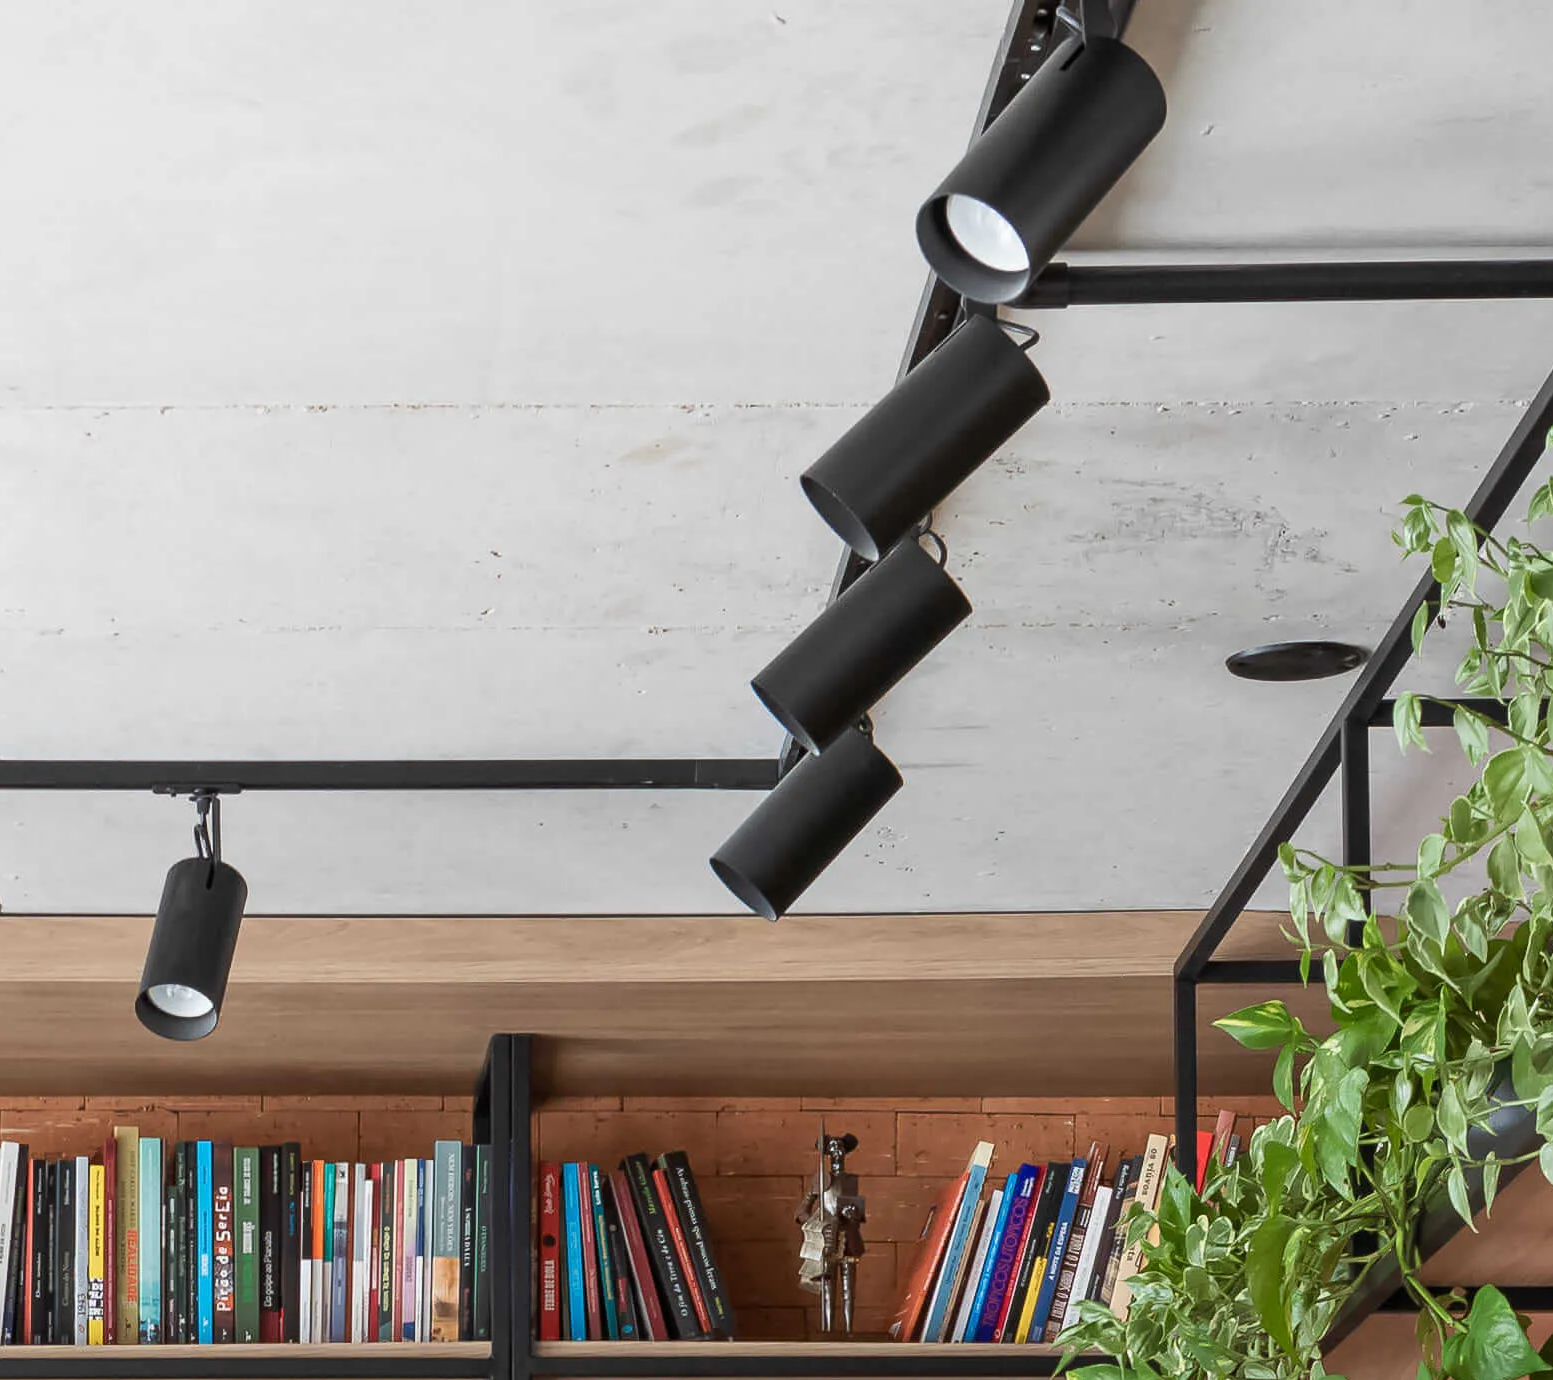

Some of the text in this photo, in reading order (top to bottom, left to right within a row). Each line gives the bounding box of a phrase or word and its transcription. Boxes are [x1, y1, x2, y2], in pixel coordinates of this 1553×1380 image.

[688, 1221, 705, 1239] que
[215, 1245, 233, 1265] de
[692, 1238, 712, 1267] poucos
[126, 1229, 138, 1303] REALIDADE
[700, 1266, 719, 1292] leram
[215, 1269, 233, 1312] Pirão
[262, 1274, 274, 1295] golpe
